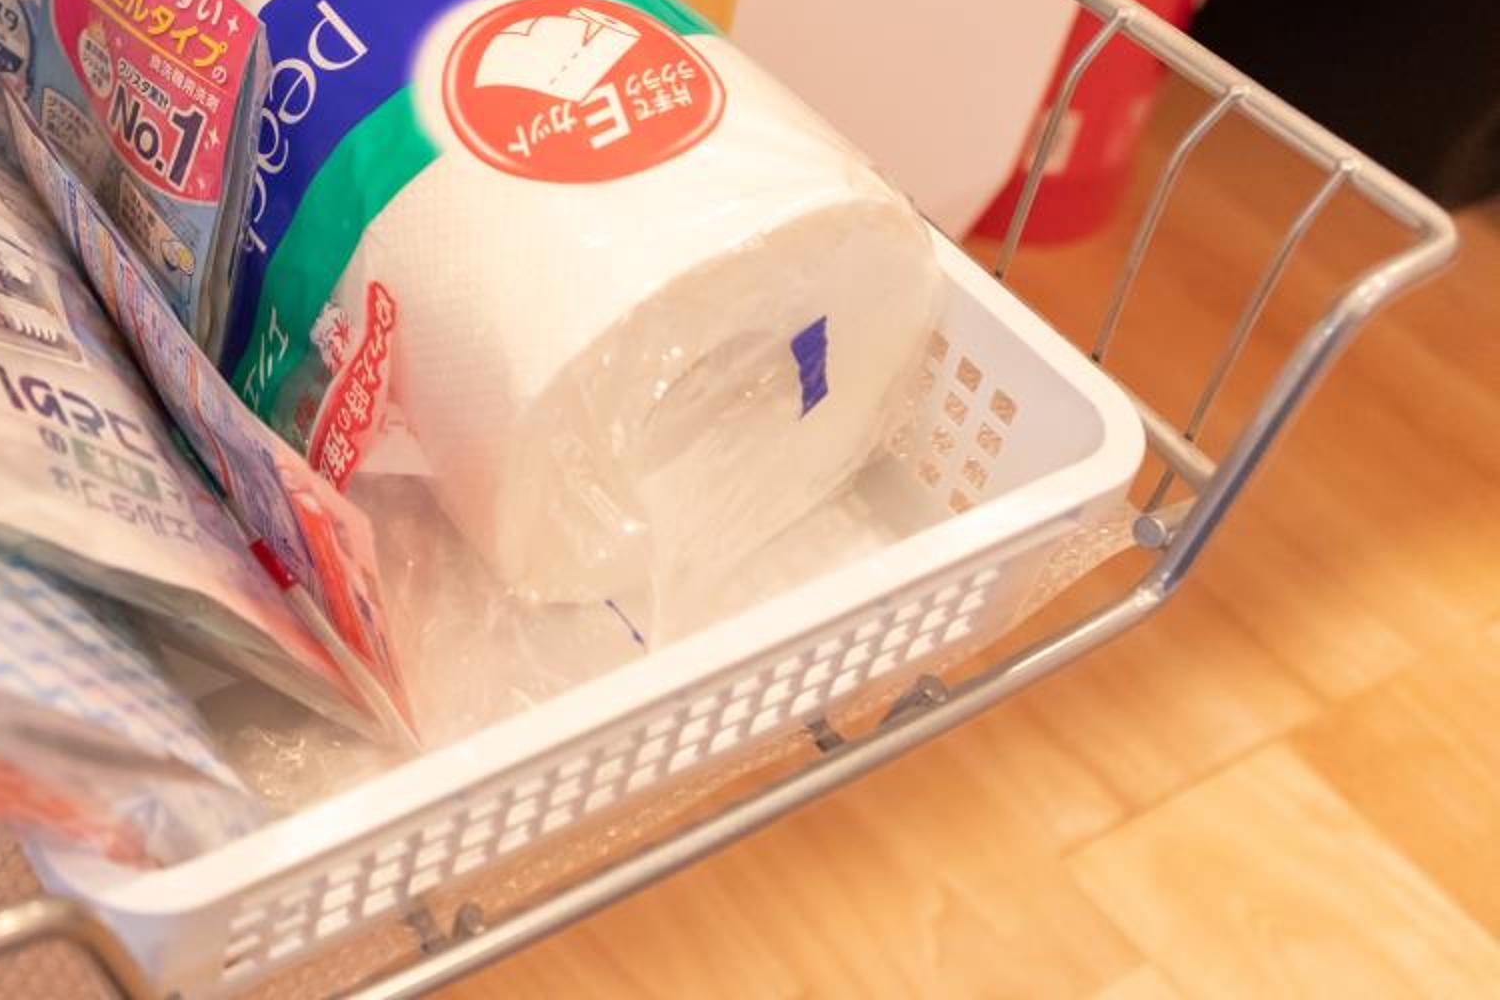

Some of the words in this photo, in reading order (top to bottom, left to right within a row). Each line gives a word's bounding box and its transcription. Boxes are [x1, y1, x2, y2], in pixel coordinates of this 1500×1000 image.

[623, 58, 697, 97] ラクラク
[633, 82, 694, 120] 片手で
[109, 85, 205, 190] No.1
[508, 99, 579, 160] カット
[578, 82, 632, 150] E
